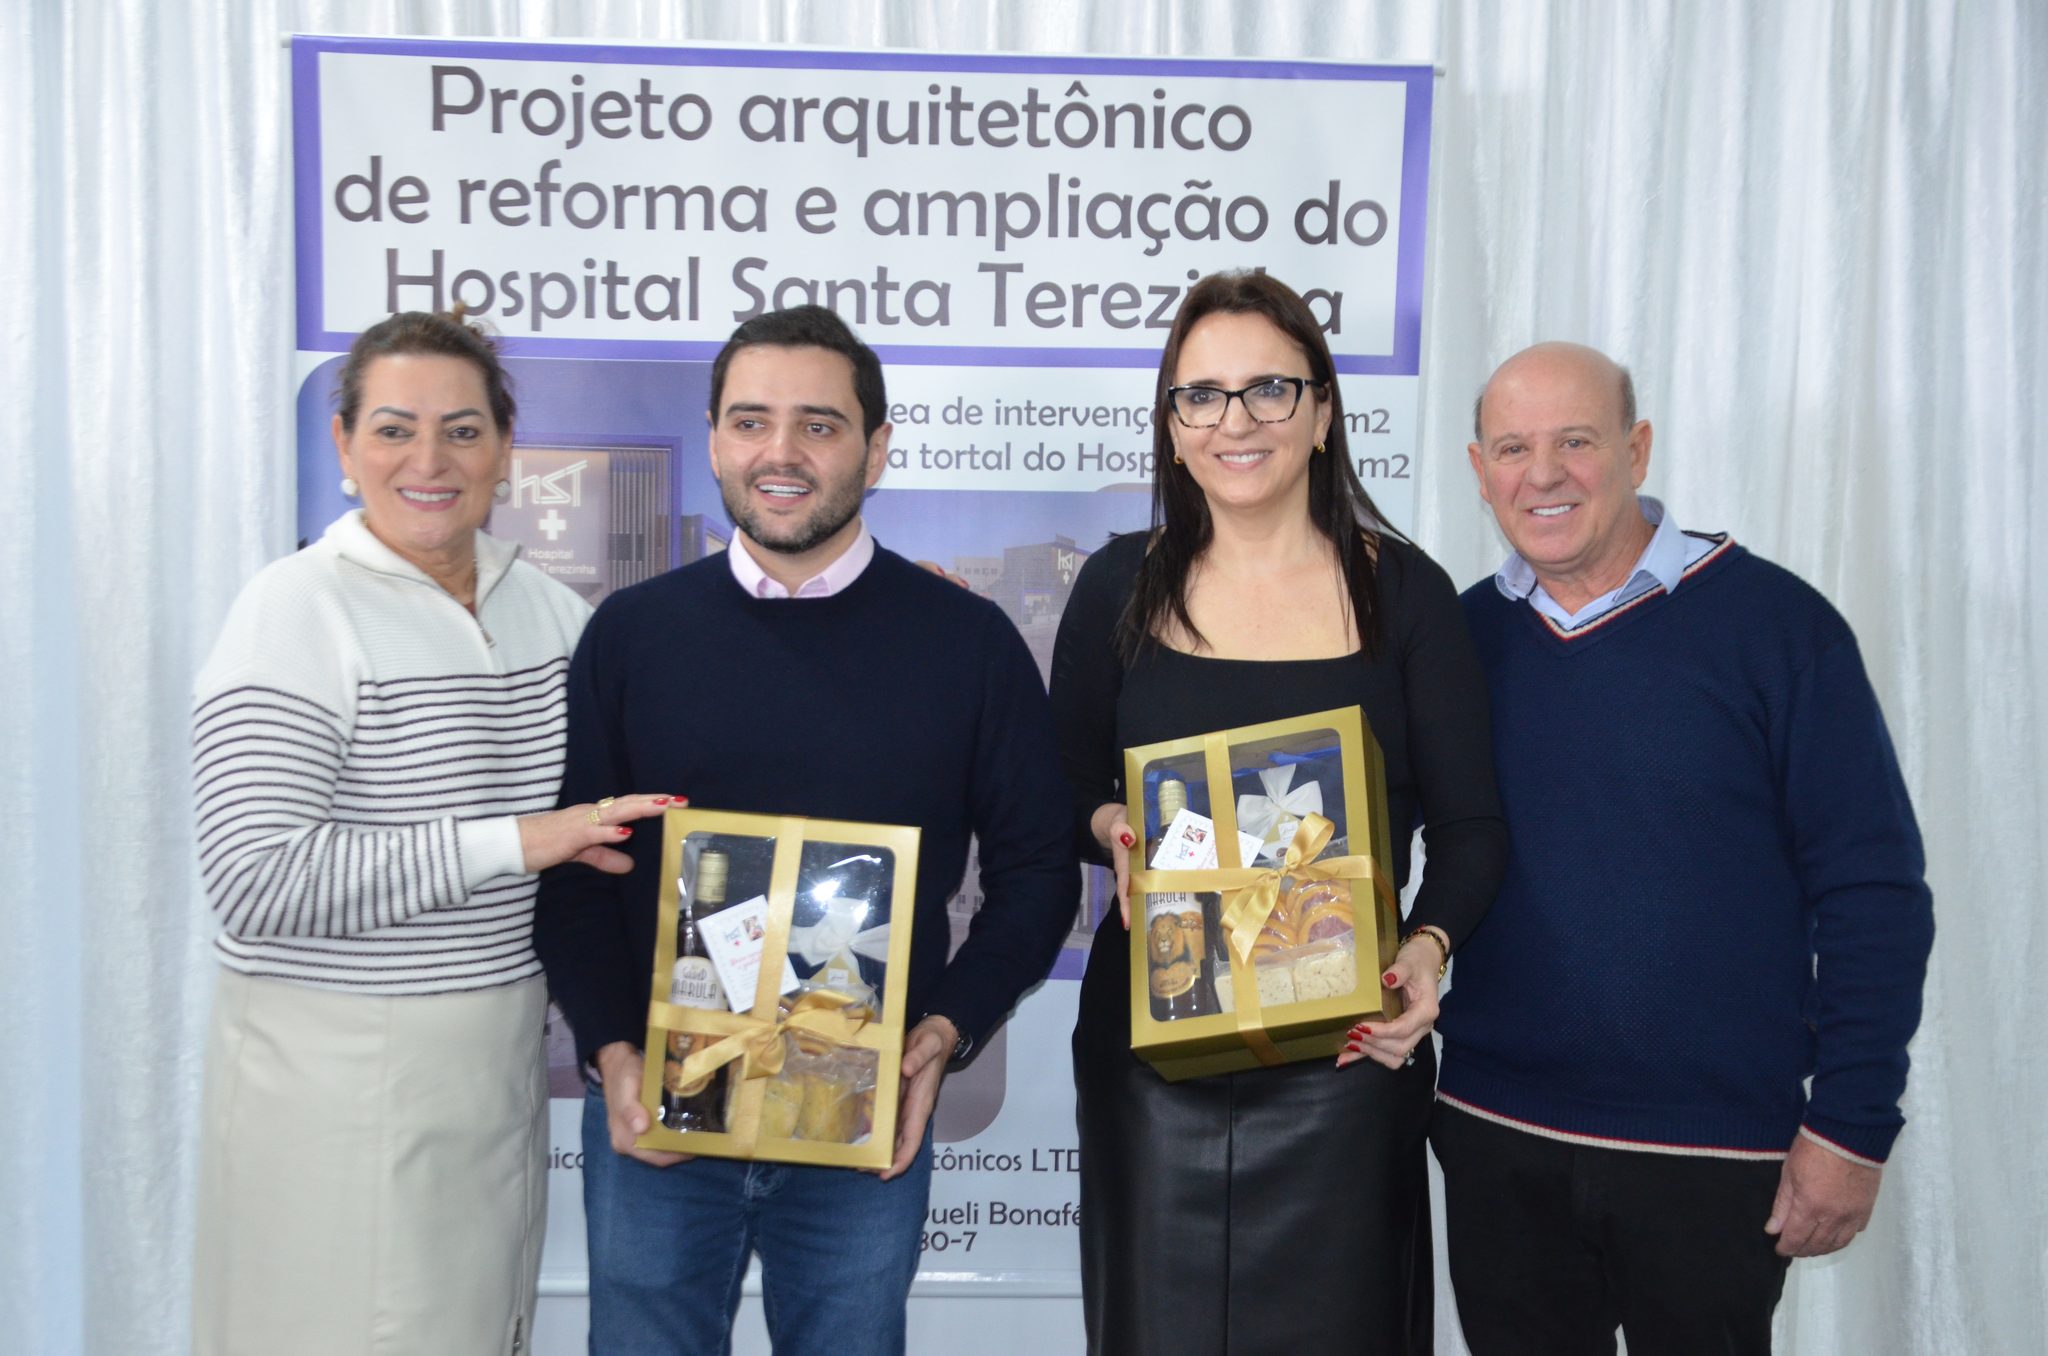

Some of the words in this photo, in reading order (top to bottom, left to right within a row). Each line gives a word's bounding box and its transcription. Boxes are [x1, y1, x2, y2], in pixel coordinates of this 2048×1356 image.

[430, 64, 712, 149] Projeto
[738, 80, 1252, 158] arquitetônico
[334, 155, 430, 224] de
[458, 159, 768, 233] reforma
[795, 187, 838, 234] e
[863, 173, 1270, 257] ampliação
[1293, 179, 1388, 247] do
[386, 248, 700, 331] Hospital
[731, 256, 952, 327] Santa
[888, 402, 931, 425] ea
[941, 396, 984, 426] de
[994, 398, 1156, 435] intervenç
[919, 441, 1012, 471] tortal
[1022, 441, 1066, 472] do
[1357, 453, 1411, 479] m2
[929, 1201, 979, 1225] ueli
